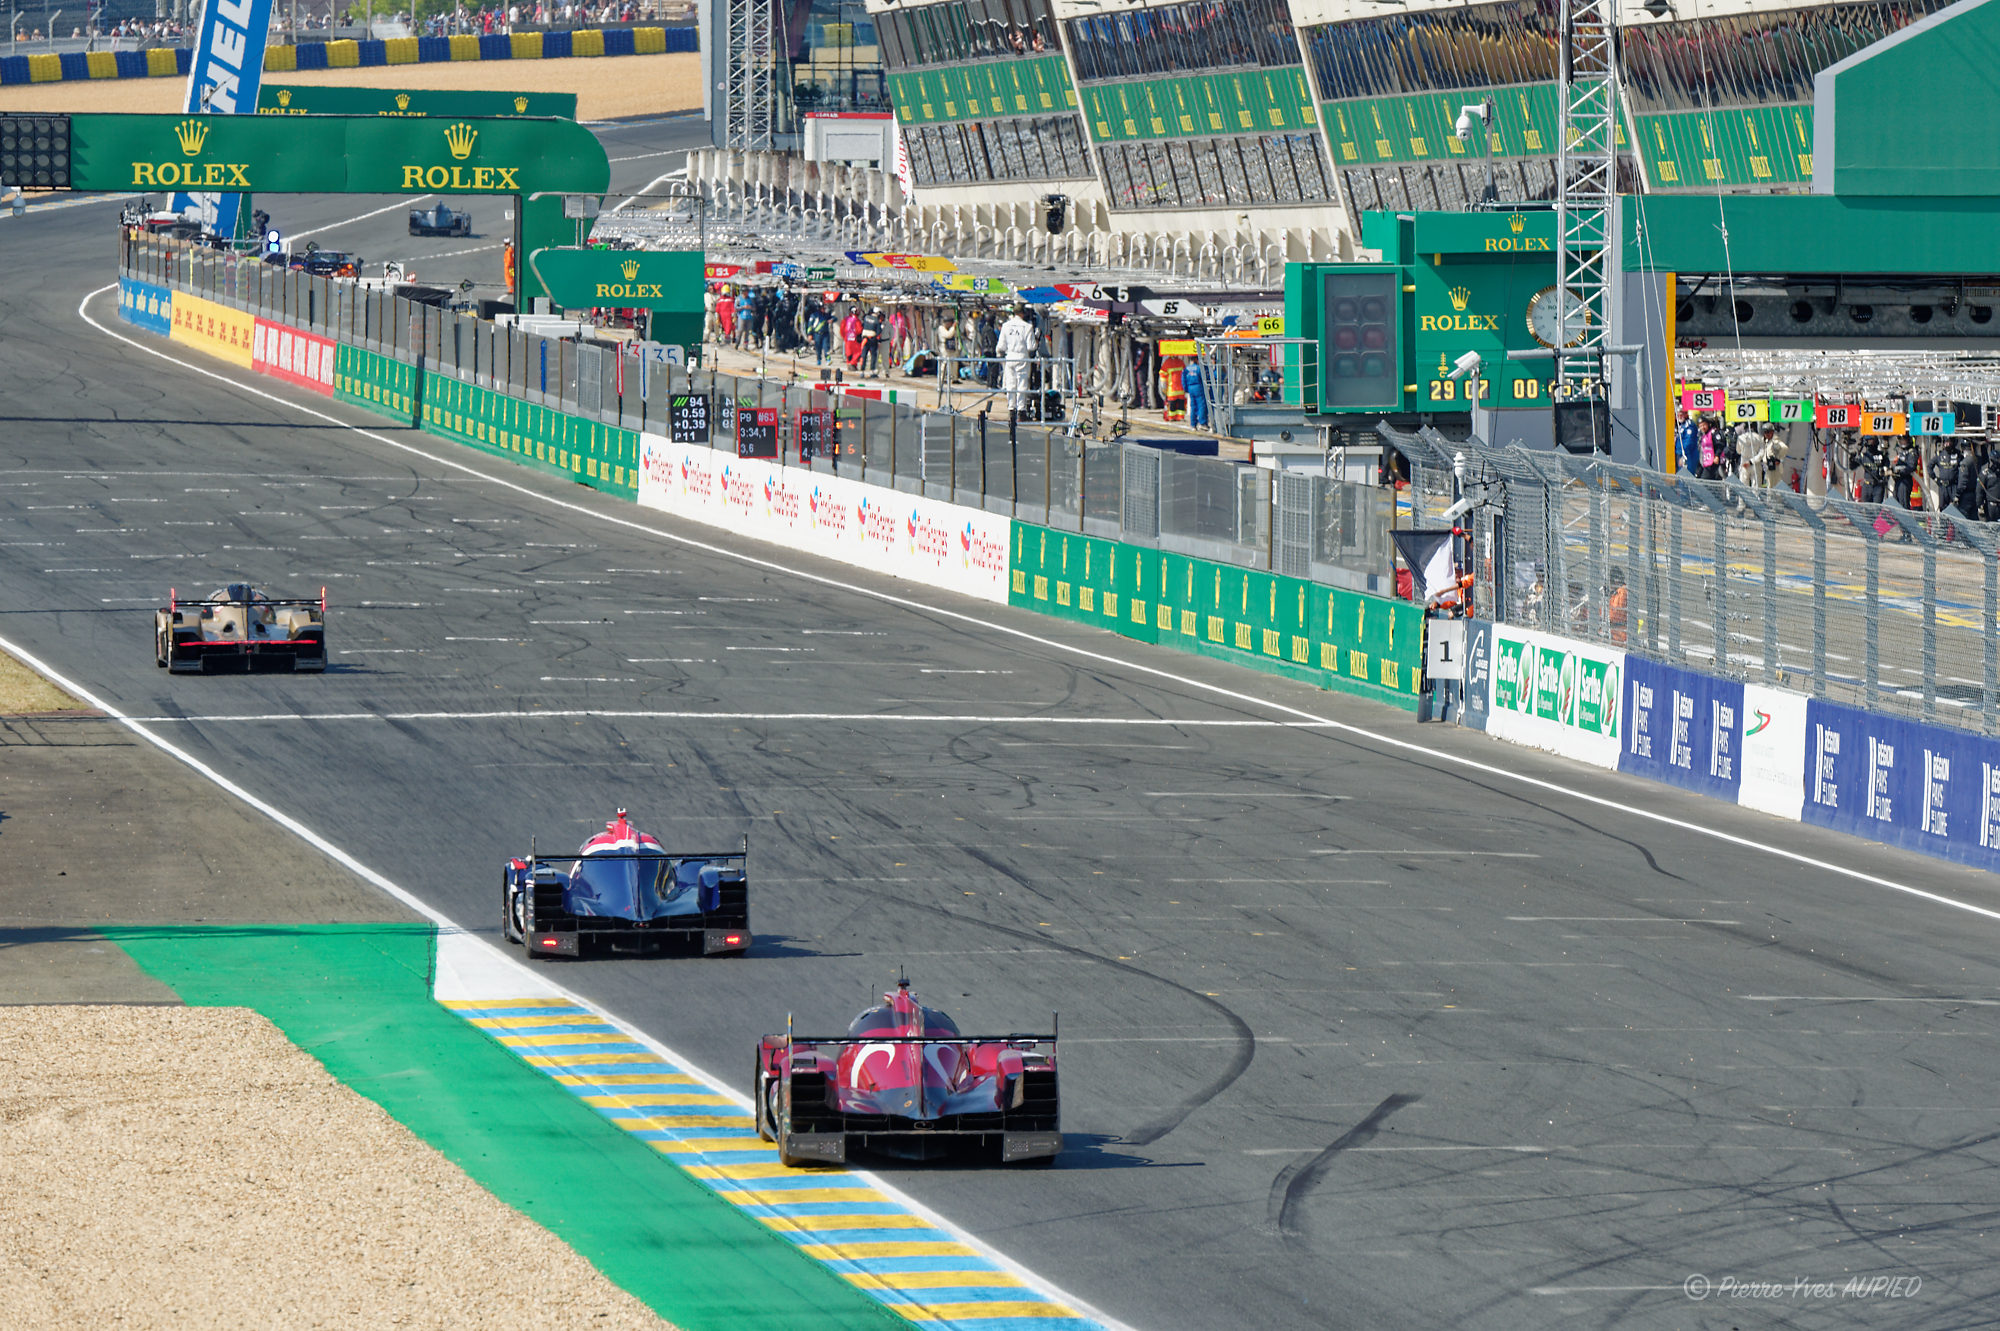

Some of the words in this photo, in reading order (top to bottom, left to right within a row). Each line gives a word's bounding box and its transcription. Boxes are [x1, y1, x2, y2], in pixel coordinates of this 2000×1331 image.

[132, 162, 251, 186] ROLEX
[401, 166, 520, 190] ROLEX
[1485, 238, 1550, 252] ROLEX
[917, 260, 926, 269] 33
[596, 284, 663, 298] ROLEX
[974, 280, 989, 290] 32
[1092, 284, 1102, 299] 6
[1117, 286, 1129, 302] 5
[1164, 302, 1179, 314] 65
[1264, 320, 1279, 330] 66
[1421, 315, 1499, 331] ROLEX
[1430, 380, 1454, 400] 29
[690, 397, 703, 406] 94
[1695, 393, 1712, 406] 85
[740, 413, 751, 422] P9
[1738, 404, 1755, 417] 60
[1784, 406, 1798, 418] 77
[1829, 410, 1846, 422] 88
[674, 420, 706, 429] +0.39
[1873, 417, 1893, 431] 911
[1925, 417, 1940, 431] 16
[675, 432, 695, 441] P11
[740, 428, 767, 439] 3:34,1
[1440, 640, 1453, 662] 1
[1498, 644, 1517, 684] Sarthe
[1539, 654, 1558, 694] Sarthe
[1581, 664, 1601, 706] Sarthe
